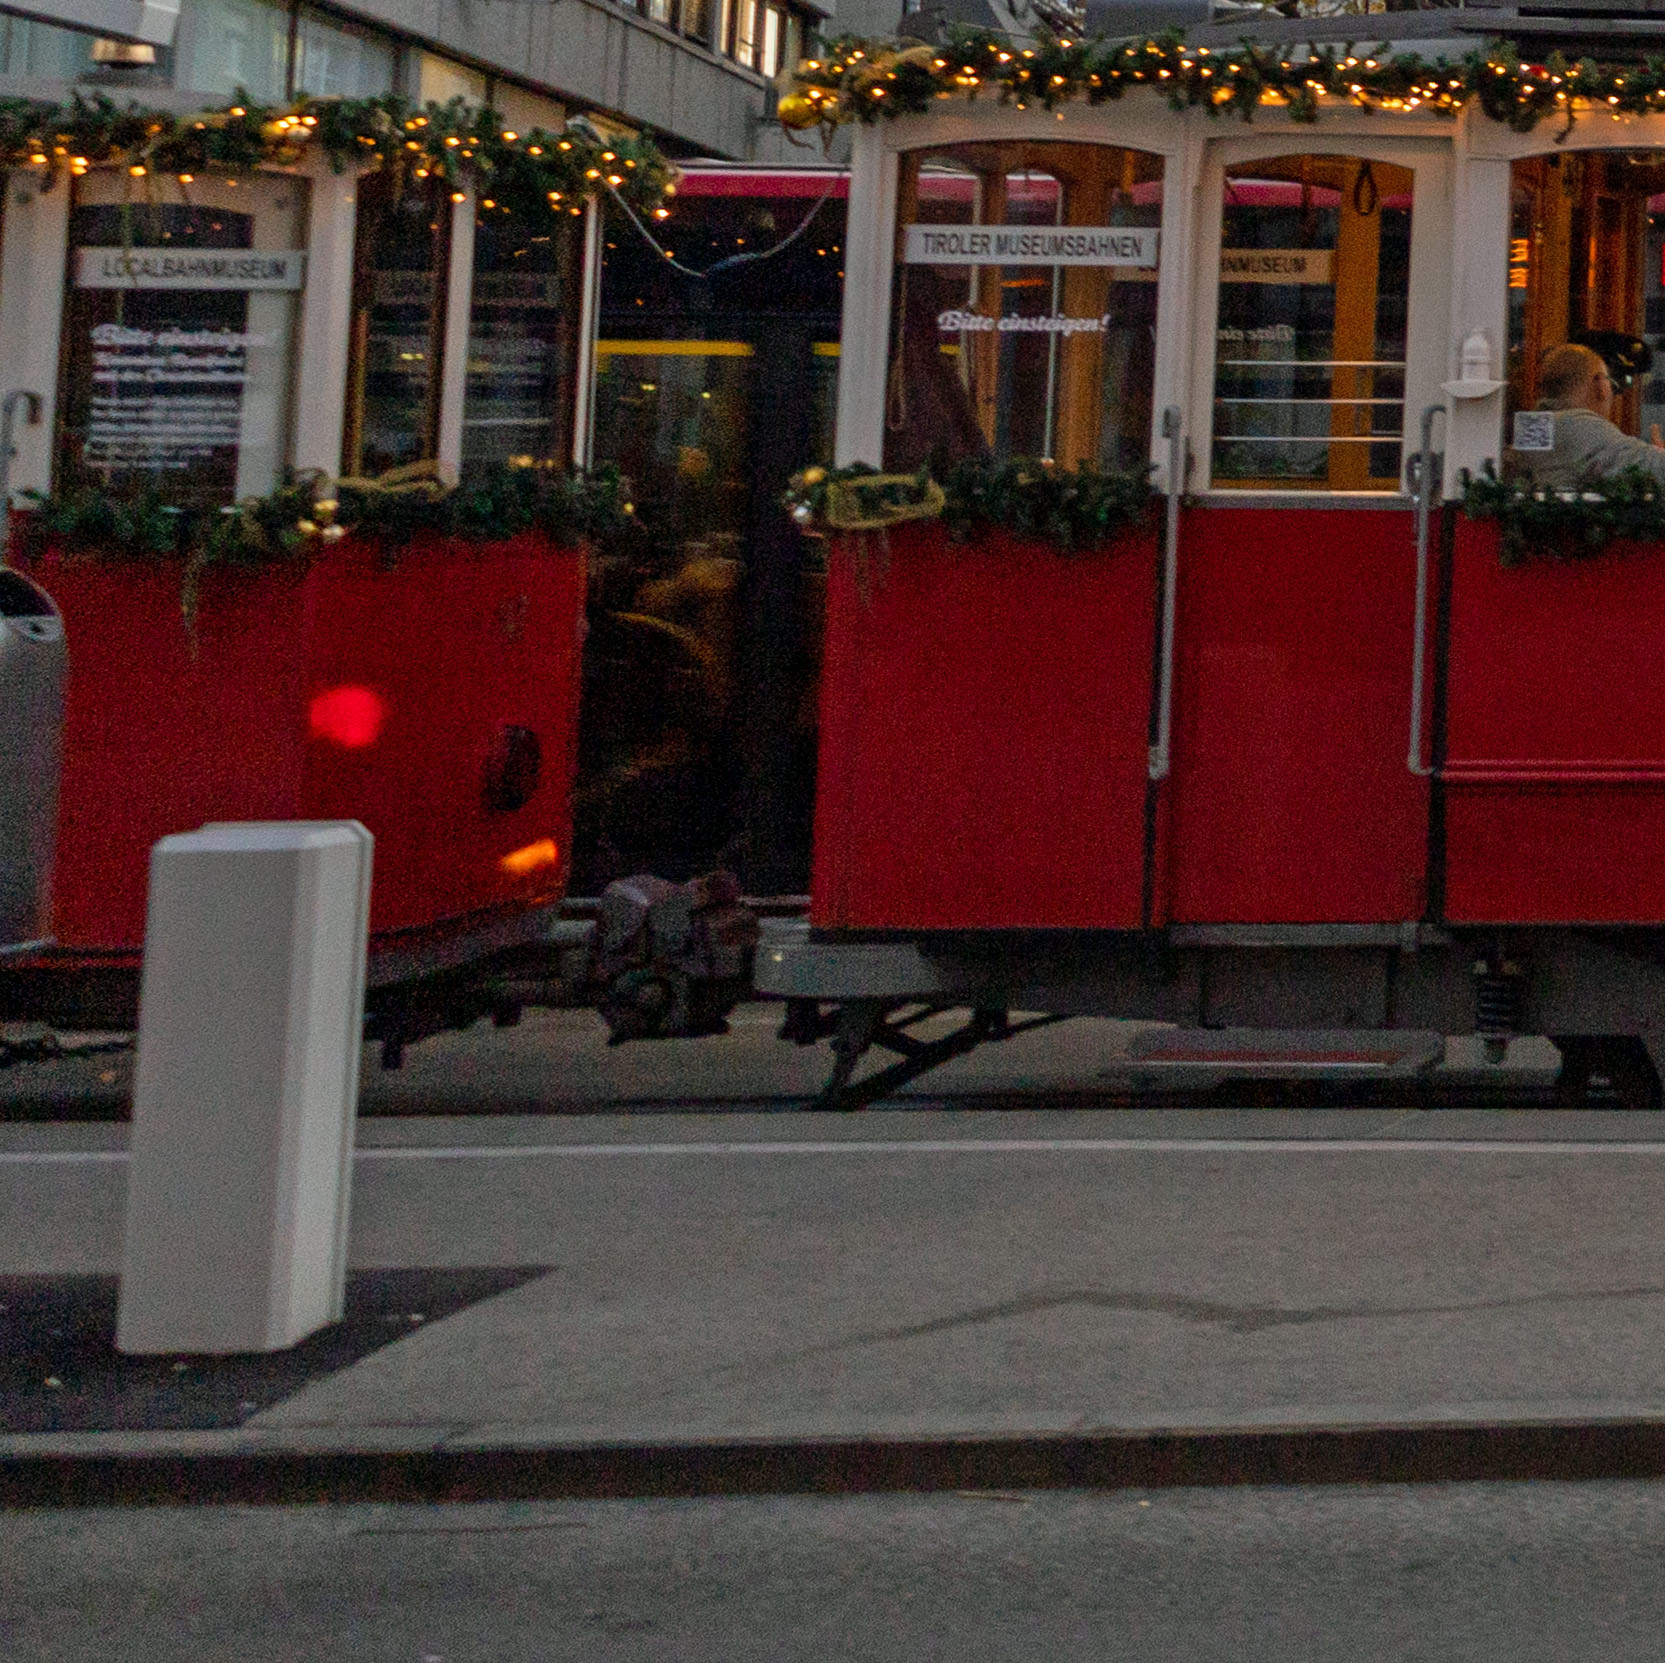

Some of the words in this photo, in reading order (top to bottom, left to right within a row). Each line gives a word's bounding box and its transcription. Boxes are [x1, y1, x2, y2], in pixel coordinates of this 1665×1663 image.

[922, 233, 990, 255] TIROLER
[998, 235, 1142, 257] MUSEUMSBAHNEN
[938, 310, 993, 333] Bitte
[998, 312, 1109, 337] einsteigen!
